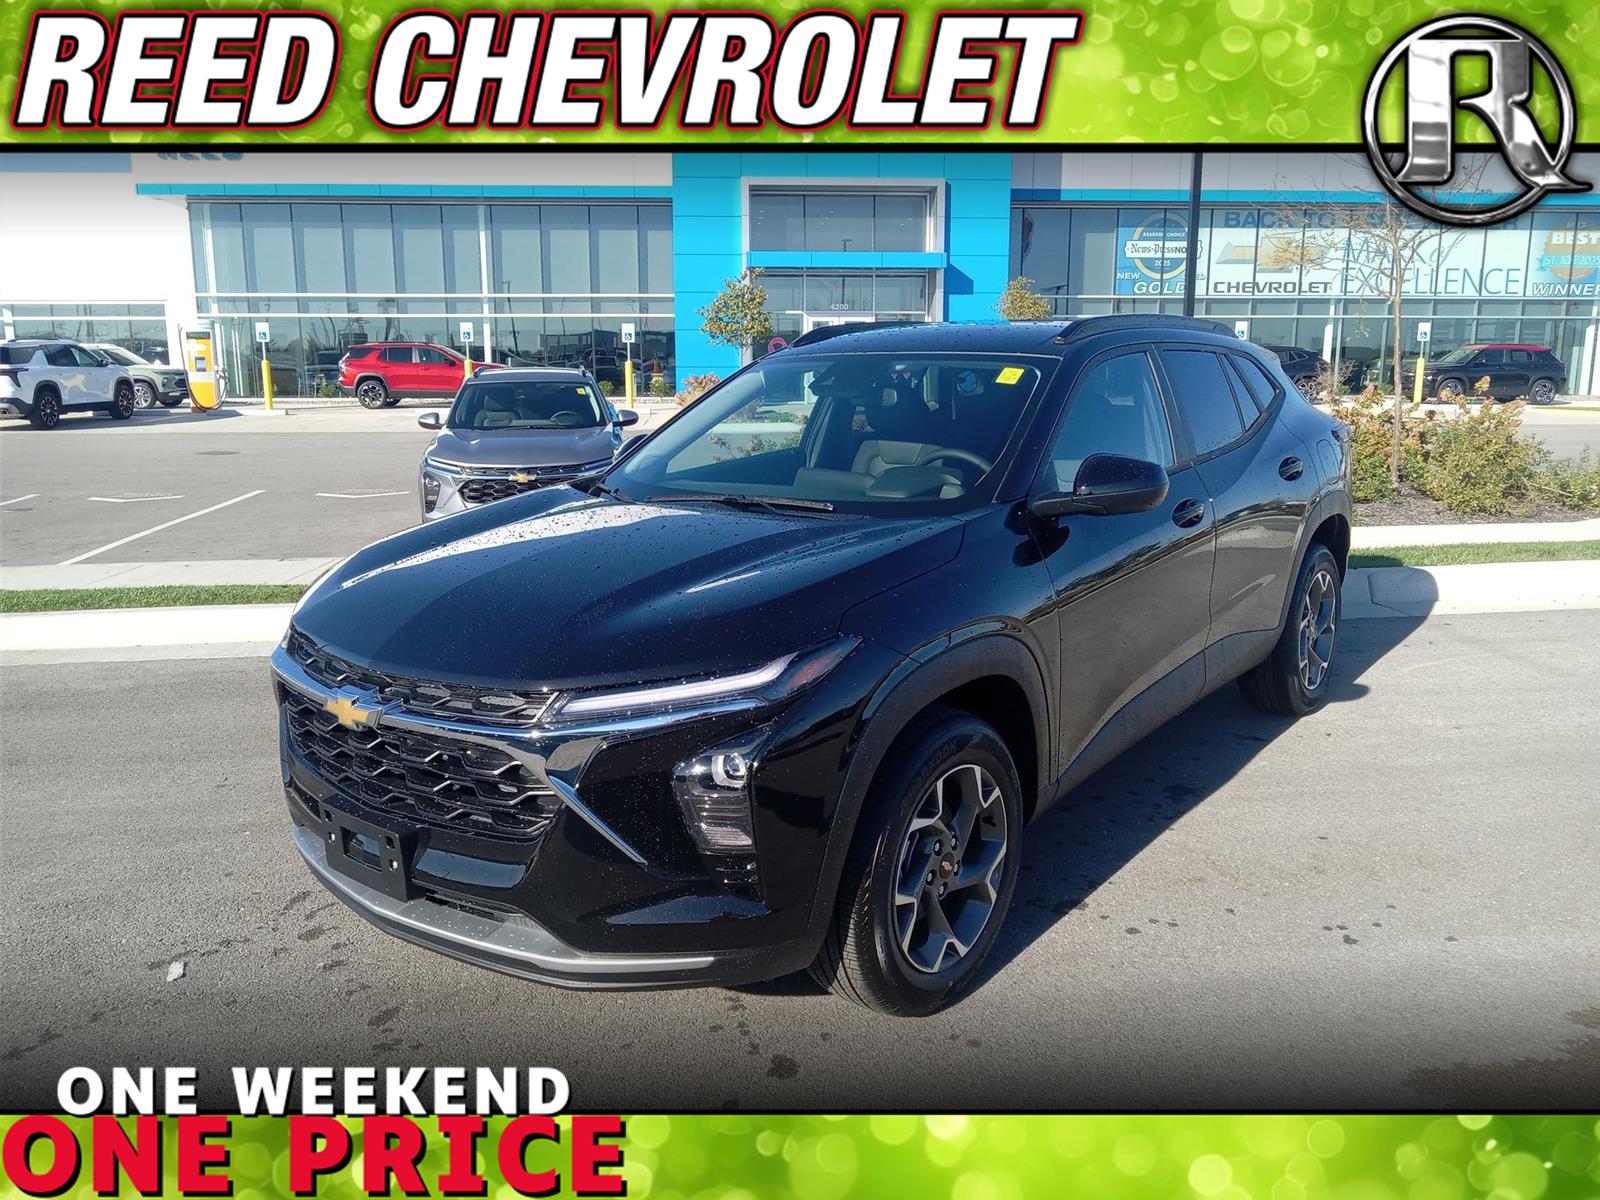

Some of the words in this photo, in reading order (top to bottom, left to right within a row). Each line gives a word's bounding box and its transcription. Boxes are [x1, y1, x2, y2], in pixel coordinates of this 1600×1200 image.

[1552, 231, 1600, 245] BEST
[1130, 243, 1188, 255] News-PressNO
[1117, 272, 1140, 280] NEW
[1213, 281, 1332, 294] CHEVROLET
[830, 303, 849, 311] 4200
